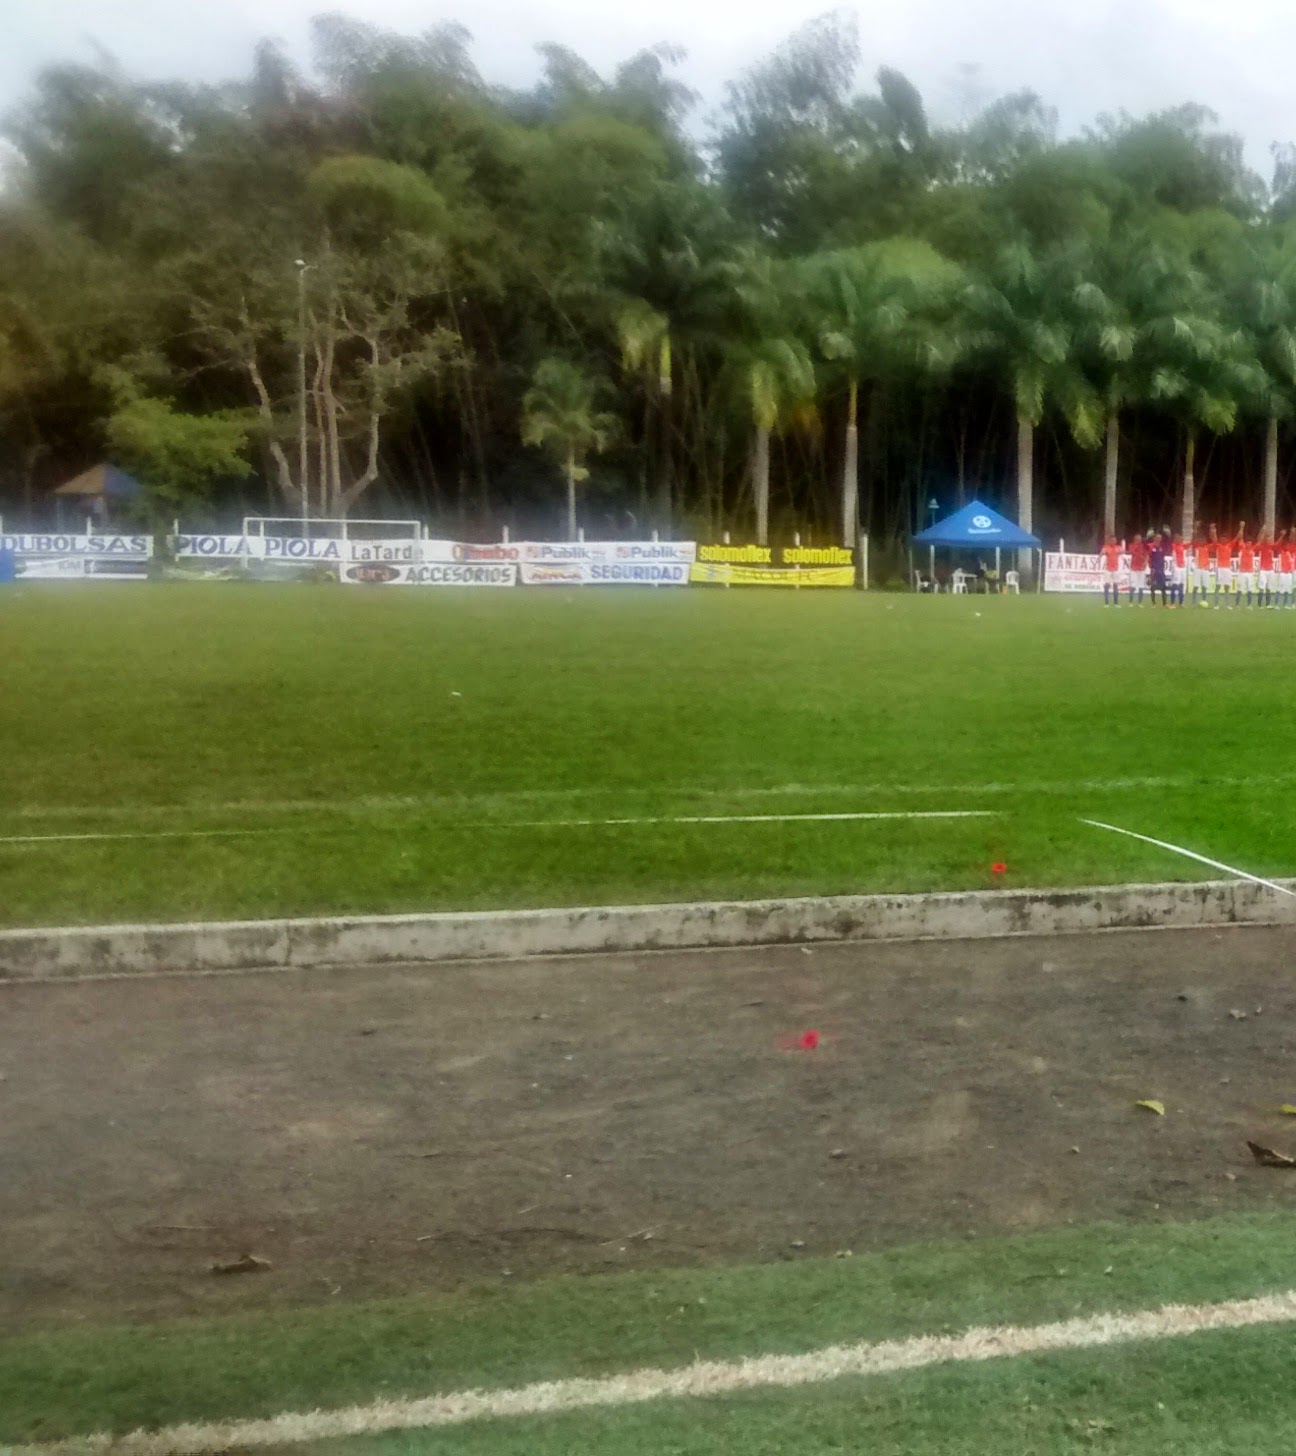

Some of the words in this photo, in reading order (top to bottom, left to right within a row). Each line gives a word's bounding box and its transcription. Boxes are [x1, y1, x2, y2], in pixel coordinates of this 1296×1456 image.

[174, 536, 252, 554] PIOLA
[265, 538, 341, 557] PIOLA
[405, 566, 512, 583] ACCESORIOS
[591, 565, 683, 580] SEGURIDAD
